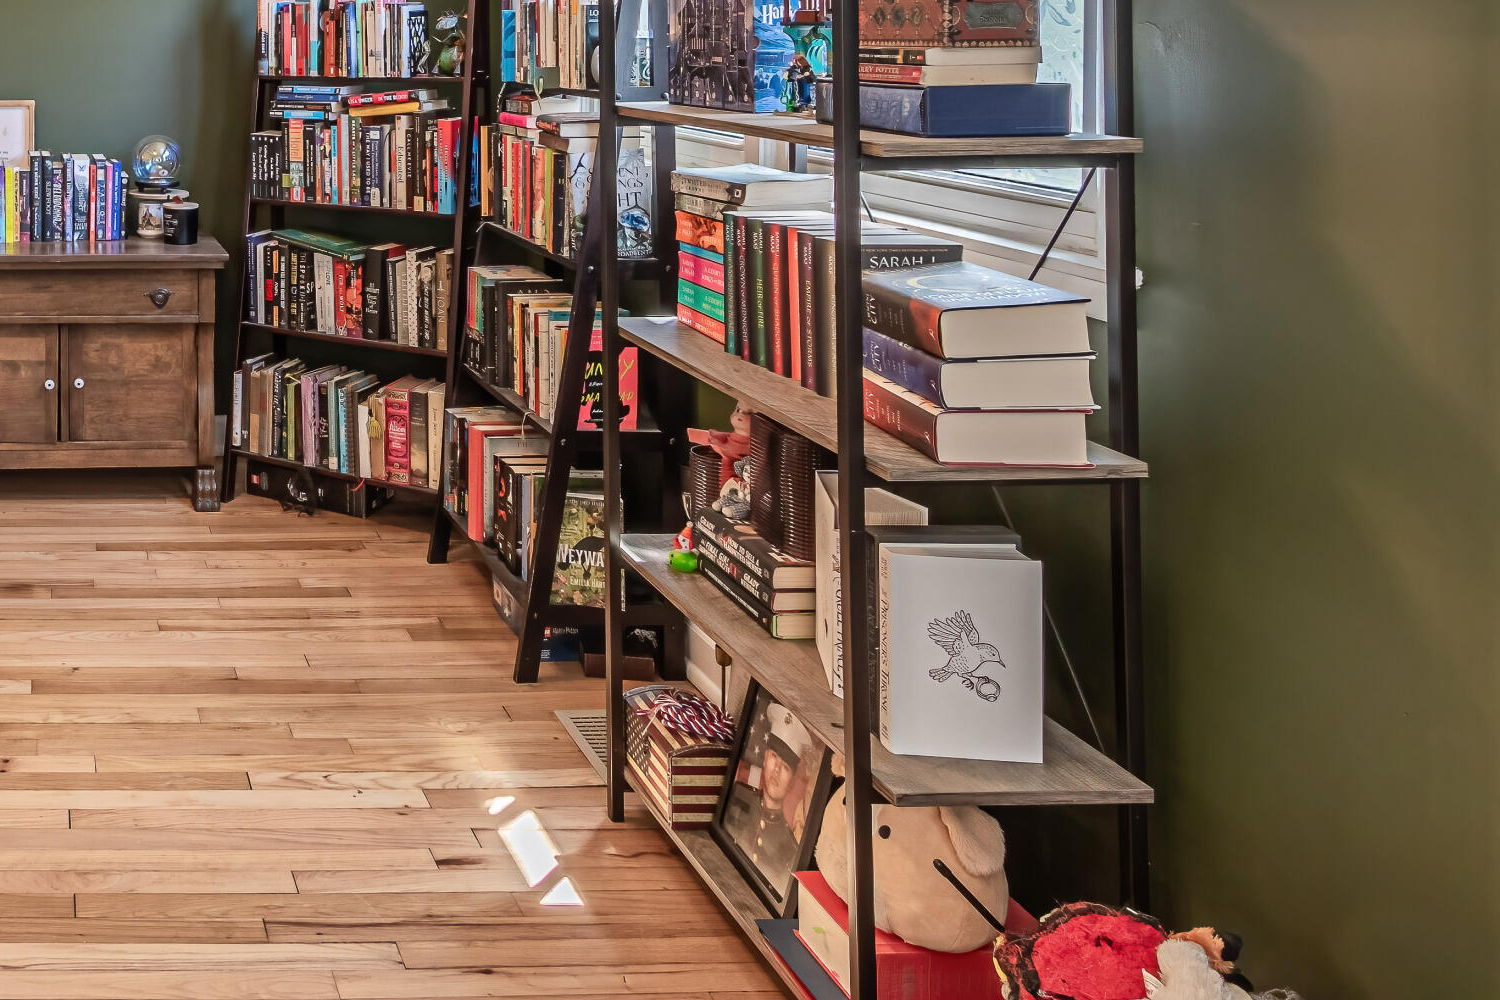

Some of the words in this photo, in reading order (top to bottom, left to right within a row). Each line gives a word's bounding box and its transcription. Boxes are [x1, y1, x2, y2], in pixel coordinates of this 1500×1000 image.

[875, 66, 899, 74] POTTER
[407, 152, 411, 160] ME
[870, 256, 923, 269] SARAH
[757, 300, 763, 310] OF
[869, 296, 878, 325] CITY
[807, 316, 811, 326] OF
[874, 343, 883, 372] CITY
[868, 391, 877, 420] CITY
[700, 515, 715, 532] GRADY
[556, 543, 604, 568] WEYWA
[705, 542, 719, 557] FINAL
[718, 552, 730, 563] GIRL
[723, 541, 746, 564] HAUNTED
[744, 557, 763, 578] HOUSE
[728, 537, 739, 549] HOW
[739, 547, 746, 555] TO
[745, 552, 756, 564] SELL
[570, 576, 590, 587] EMILIA
[743, 573, 760, 589] GRADY
[881, 599, 890, 666] PRISONER'S
[881, 668, 890, 713] THRONE
